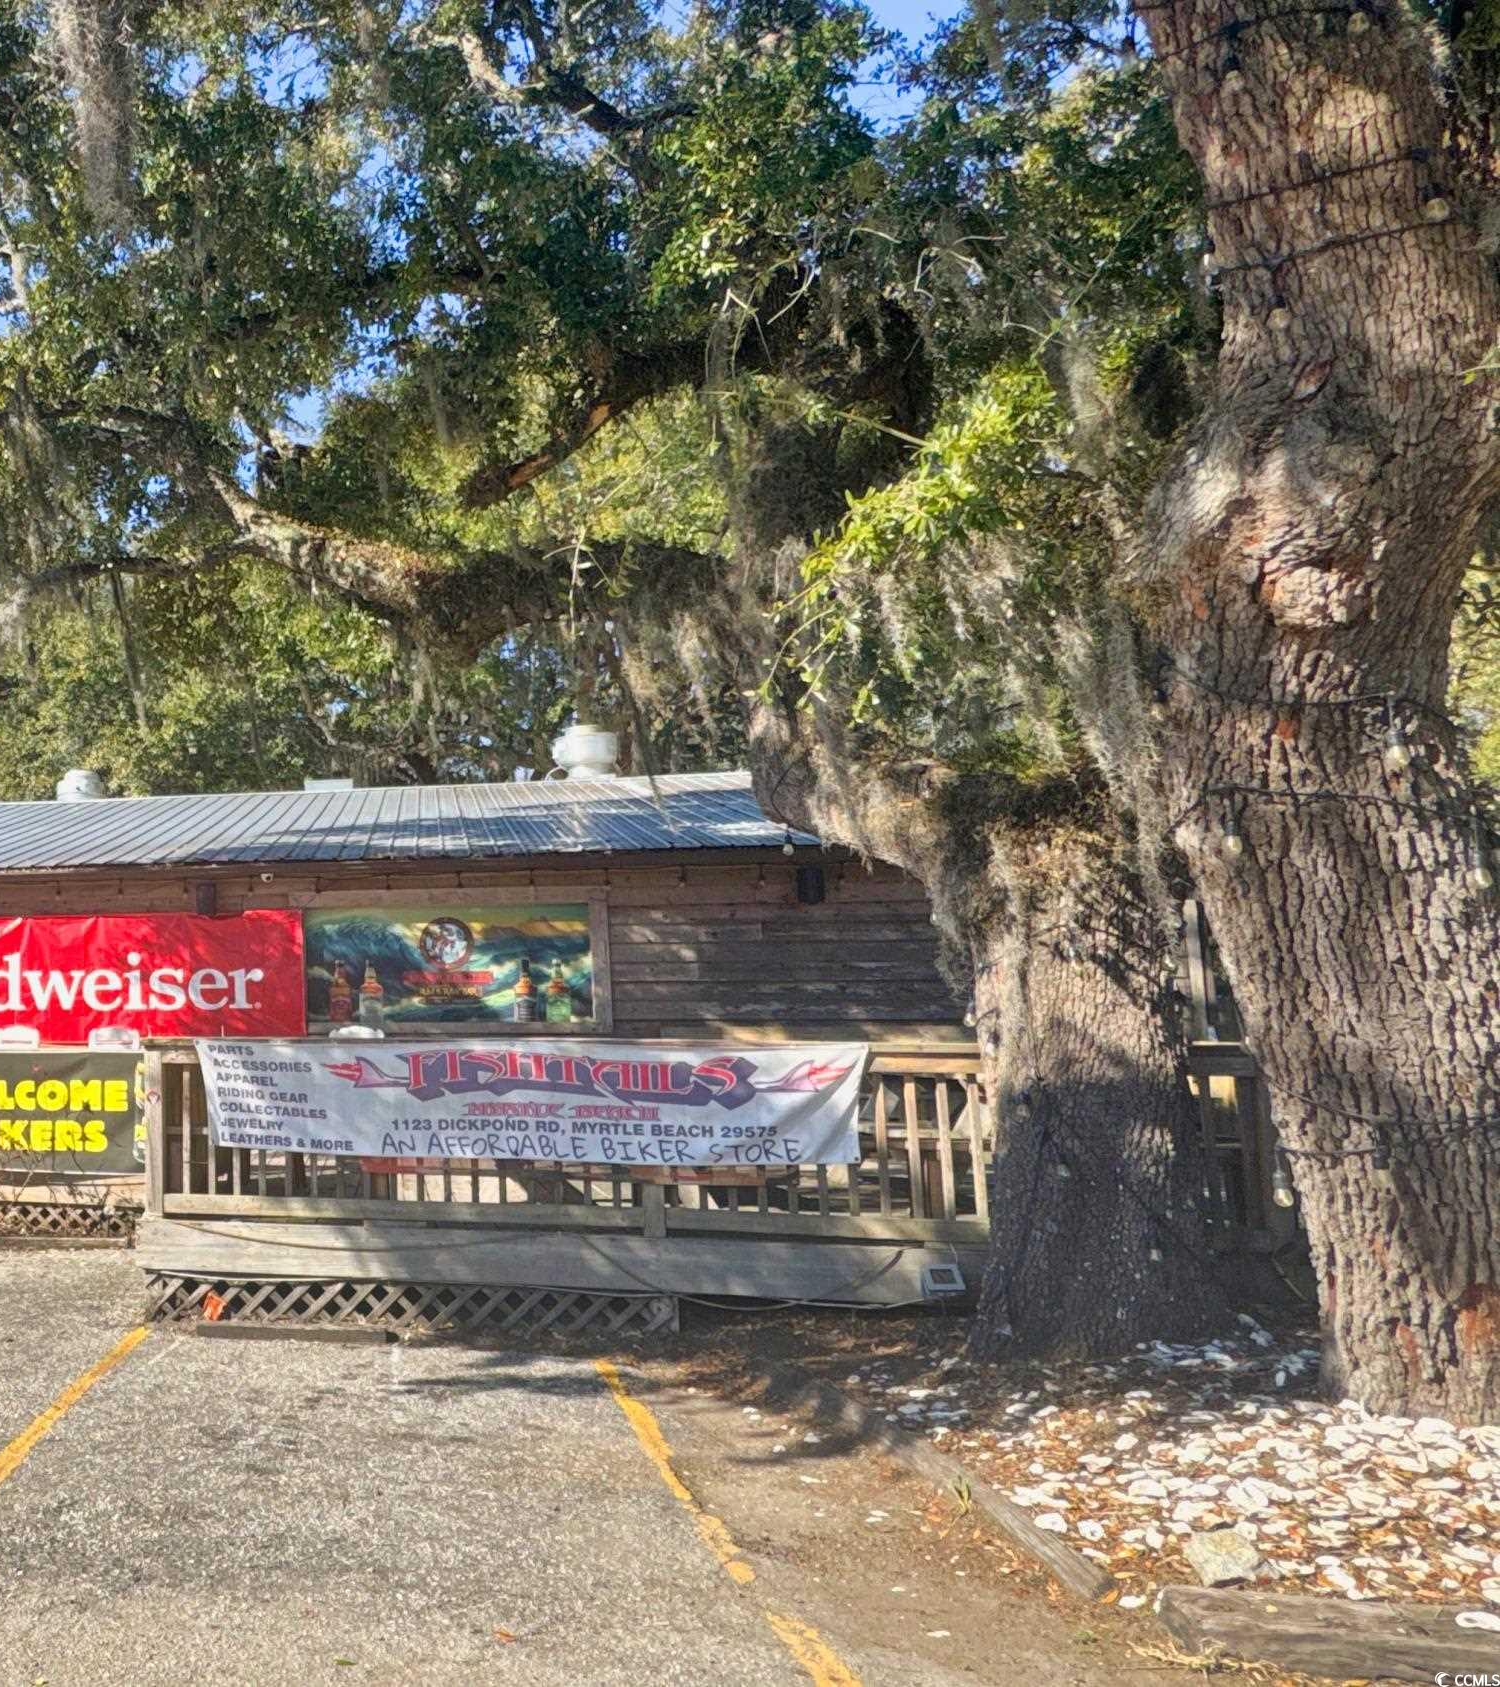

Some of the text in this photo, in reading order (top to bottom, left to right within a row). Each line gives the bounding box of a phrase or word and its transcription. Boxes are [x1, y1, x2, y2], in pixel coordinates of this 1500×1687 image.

[208, 1044, 254, 1056] PARTS
[213, 1059, 312, 1073] ACCESSORIES
[216, 1073, 277, 1087] APPAREL
[403, 1049, 740, 1105] FISHTAILS
[217, 1086, 308, 1103] RIDING GEAR
[219, 1102, 328, 1119] COLLECTABLES
[221, 1117, 283, 1131] JEWELRY
[392, 1118, 778, 1138] 1123 DICKPOND RD, MYRTLE BEACH 29575
[221, 1132, 354, 1151] LEATHERS & MORE
[381, 1132, 802, 1164] AN AFFORDABLE BIKER STORE
